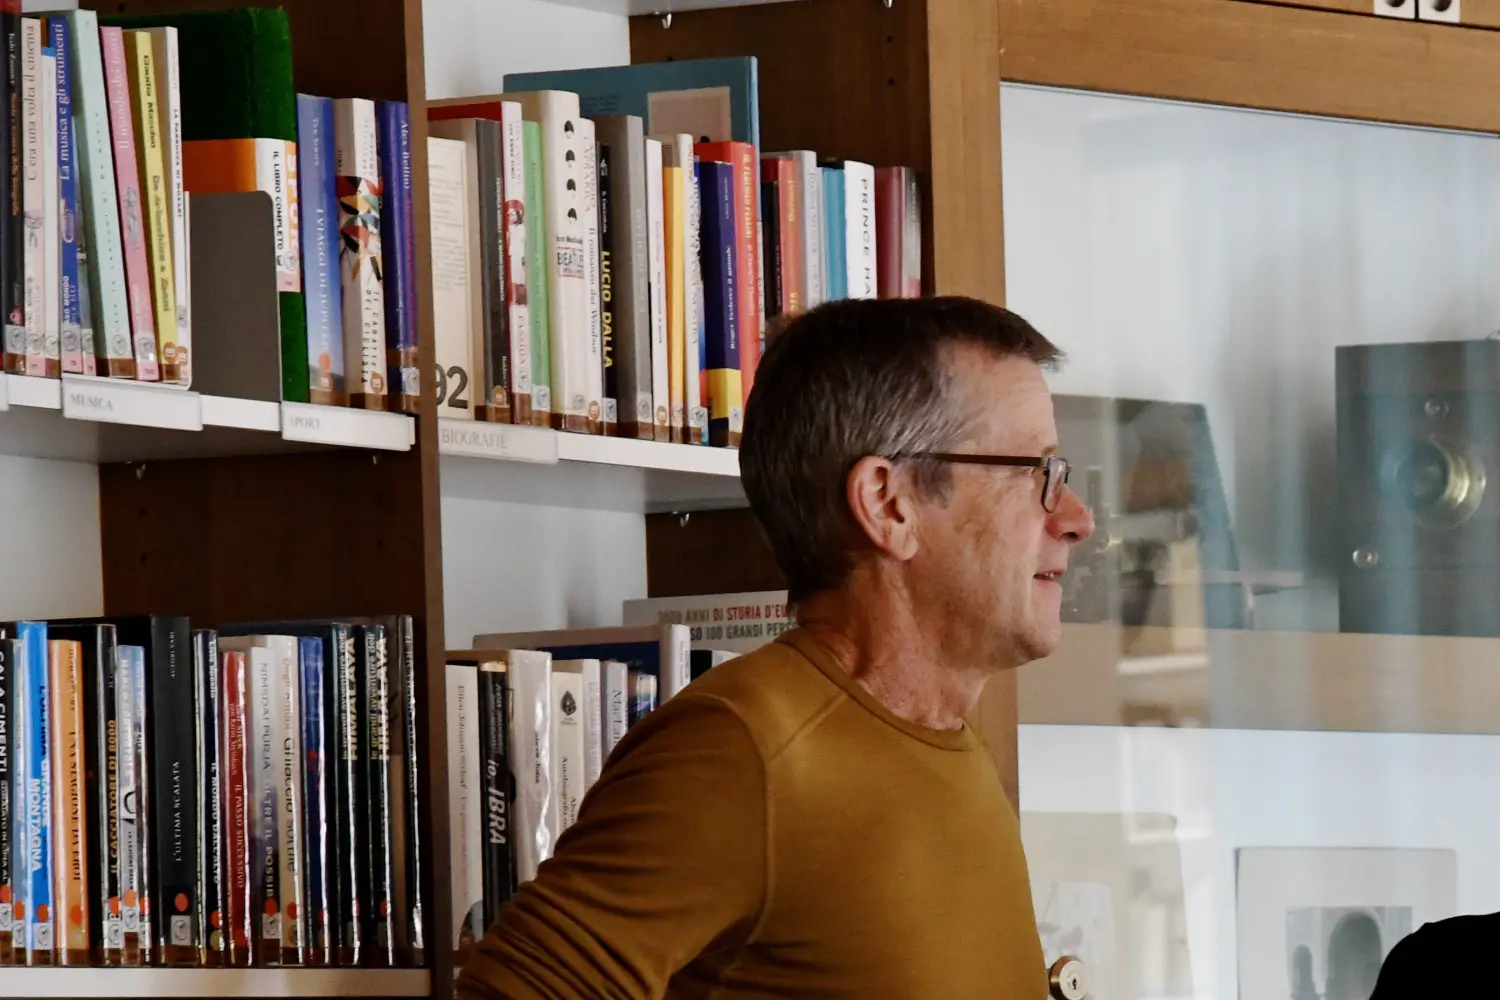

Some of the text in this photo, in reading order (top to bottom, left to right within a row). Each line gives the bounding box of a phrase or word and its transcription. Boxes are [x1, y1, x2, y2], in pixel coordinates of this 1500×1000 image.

[24, 26, 35, 71] cinema
[52, 24, 67, 85] strumenti
[25, 87, 36, 116] volta
[55, 89, 71, 104] gli
[28, 122, 36, 144] una
[58, 118, 69, 160] musica
[401, 119, 409, 146] Alex
[59, 165, 70, 180] La
[273, 151, 284, 250] IL LIBRO COMPLETO
[287, 153, 300, 250] SPOR
[861, 179, 869, 256] PRINCE
[317, 217, 327, 287] VIAGGI DI
[588, 238, 596, 283] romanzo
[601, 251, 613, 368] LUCIO DALLA
[360, 324, 369, 384] CICLISTA
[590, 310, 599, 355] Windsor
[70, 393, 114, 412] MUSICA
[441, 427, 509, 450] BIOGRAFIE
[686, 605, 760, 622] ANNI DI STORIA
[707, 624, 762, 640] 100 GRANDI
[108, 720, 118, 752] 8000
[260, 663, 272, 770] NIMSDAI PURJA
[109, 756, 119, 770] DI
[41, 760, 50, 827] GRANDE
[69, 764, 80, 822] STAGIONE
[172, 761, 182, 861] L'ULTIMA SCALATA
[488, 787, 506, 844] IBRA
[31, 779, 42, 871] MONTAGNA
[71, 829, 81, 845] DA
[109, 774, 119, 858] CACCIATORE
[235, 784, 244, 888] IL PASSO SUCCESSIVO
[264, 830, 273, 840] IL
[1, 843, 10, 866] CIMA
